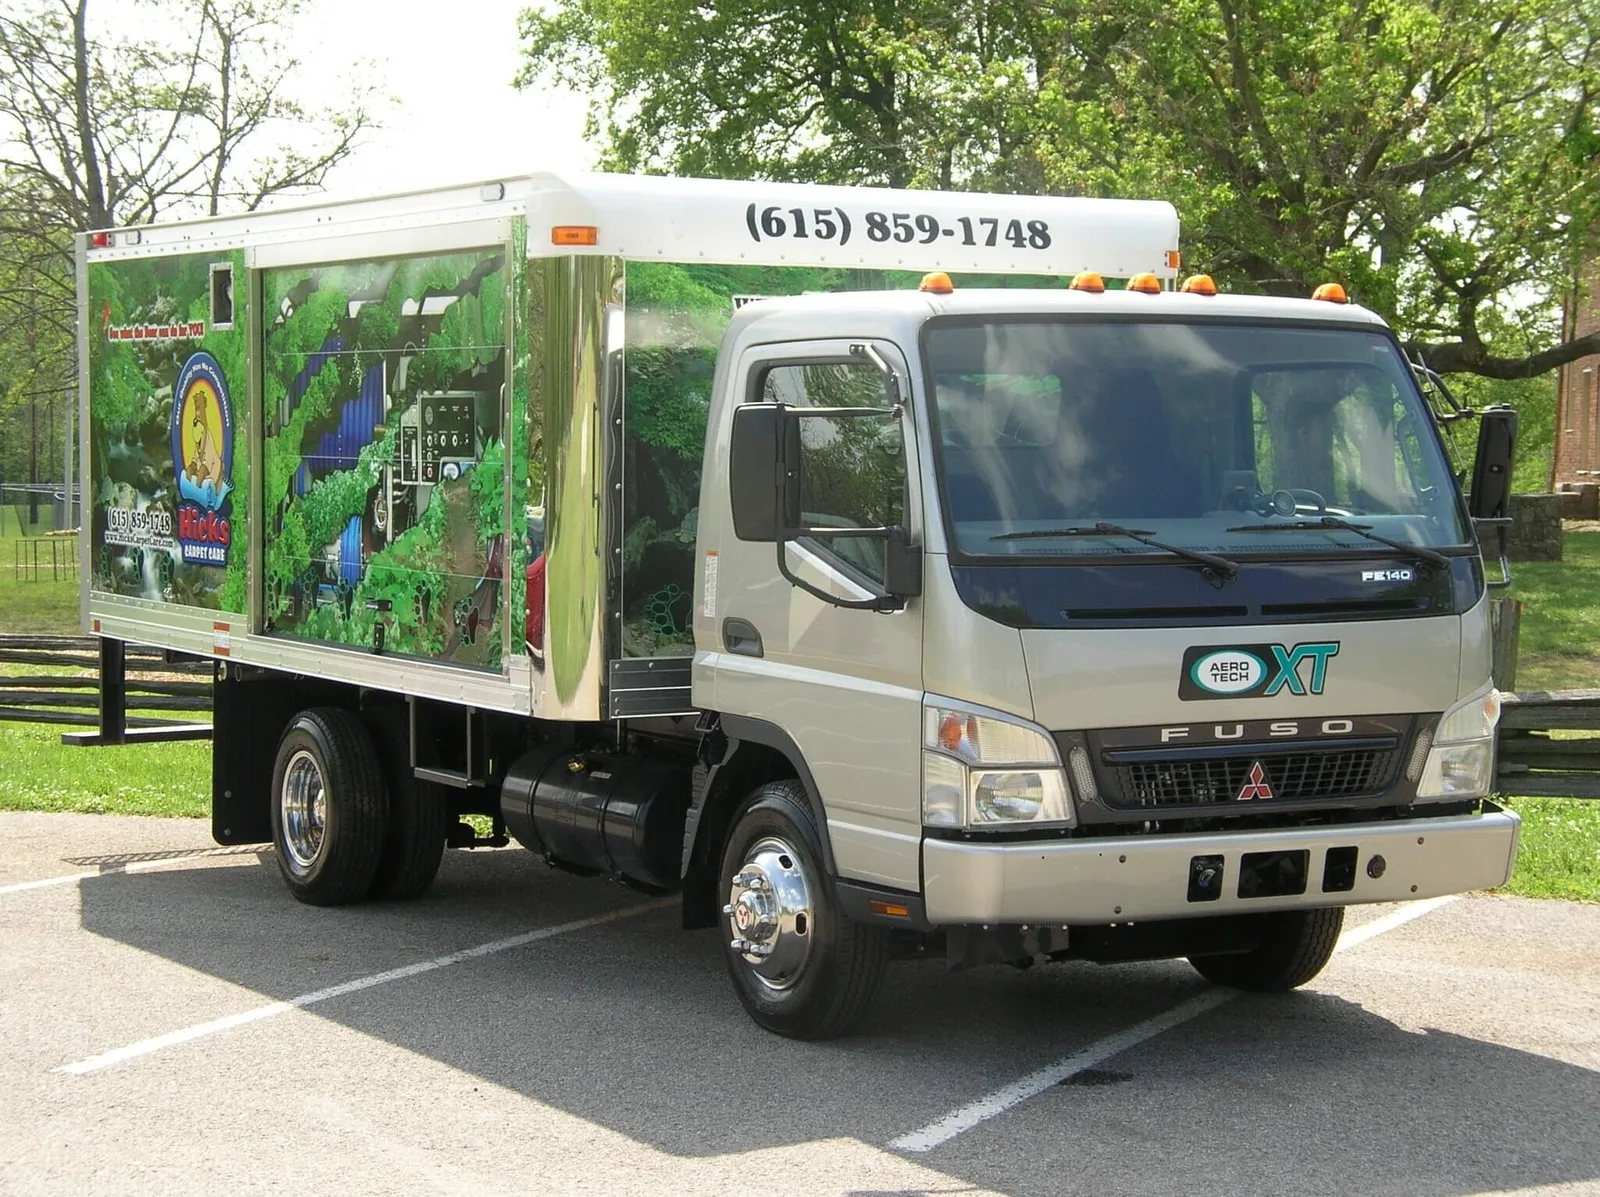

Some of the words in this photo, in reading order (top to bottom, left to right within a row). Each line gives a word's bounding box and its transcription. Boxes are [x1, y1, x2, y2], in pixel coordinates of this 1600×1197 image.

[746, 203, 852, 246] (615)
[865, 211, 1052, 250] 859-1748
[180, 370, 193, 399] Quality
[201, 362, 209, 370] No
[209, 366, 230, 427] Competition
[108, 508, 129, 530] (615)
[131, 511, 171, 532] 859-1748
[178, 506, 230, 546] Hicks
[184, 544, 208, 560] CARPET
[208, 548, 225, 561] CARE
[1362, 570, 1411, 582] FE140
[1210, 661, 1249, 673] AERO
[1211, 672, 1249, 683] TECH
[1264, 640, 1341, 695] XT
[1161, 719, 1354, 743] FUSO
